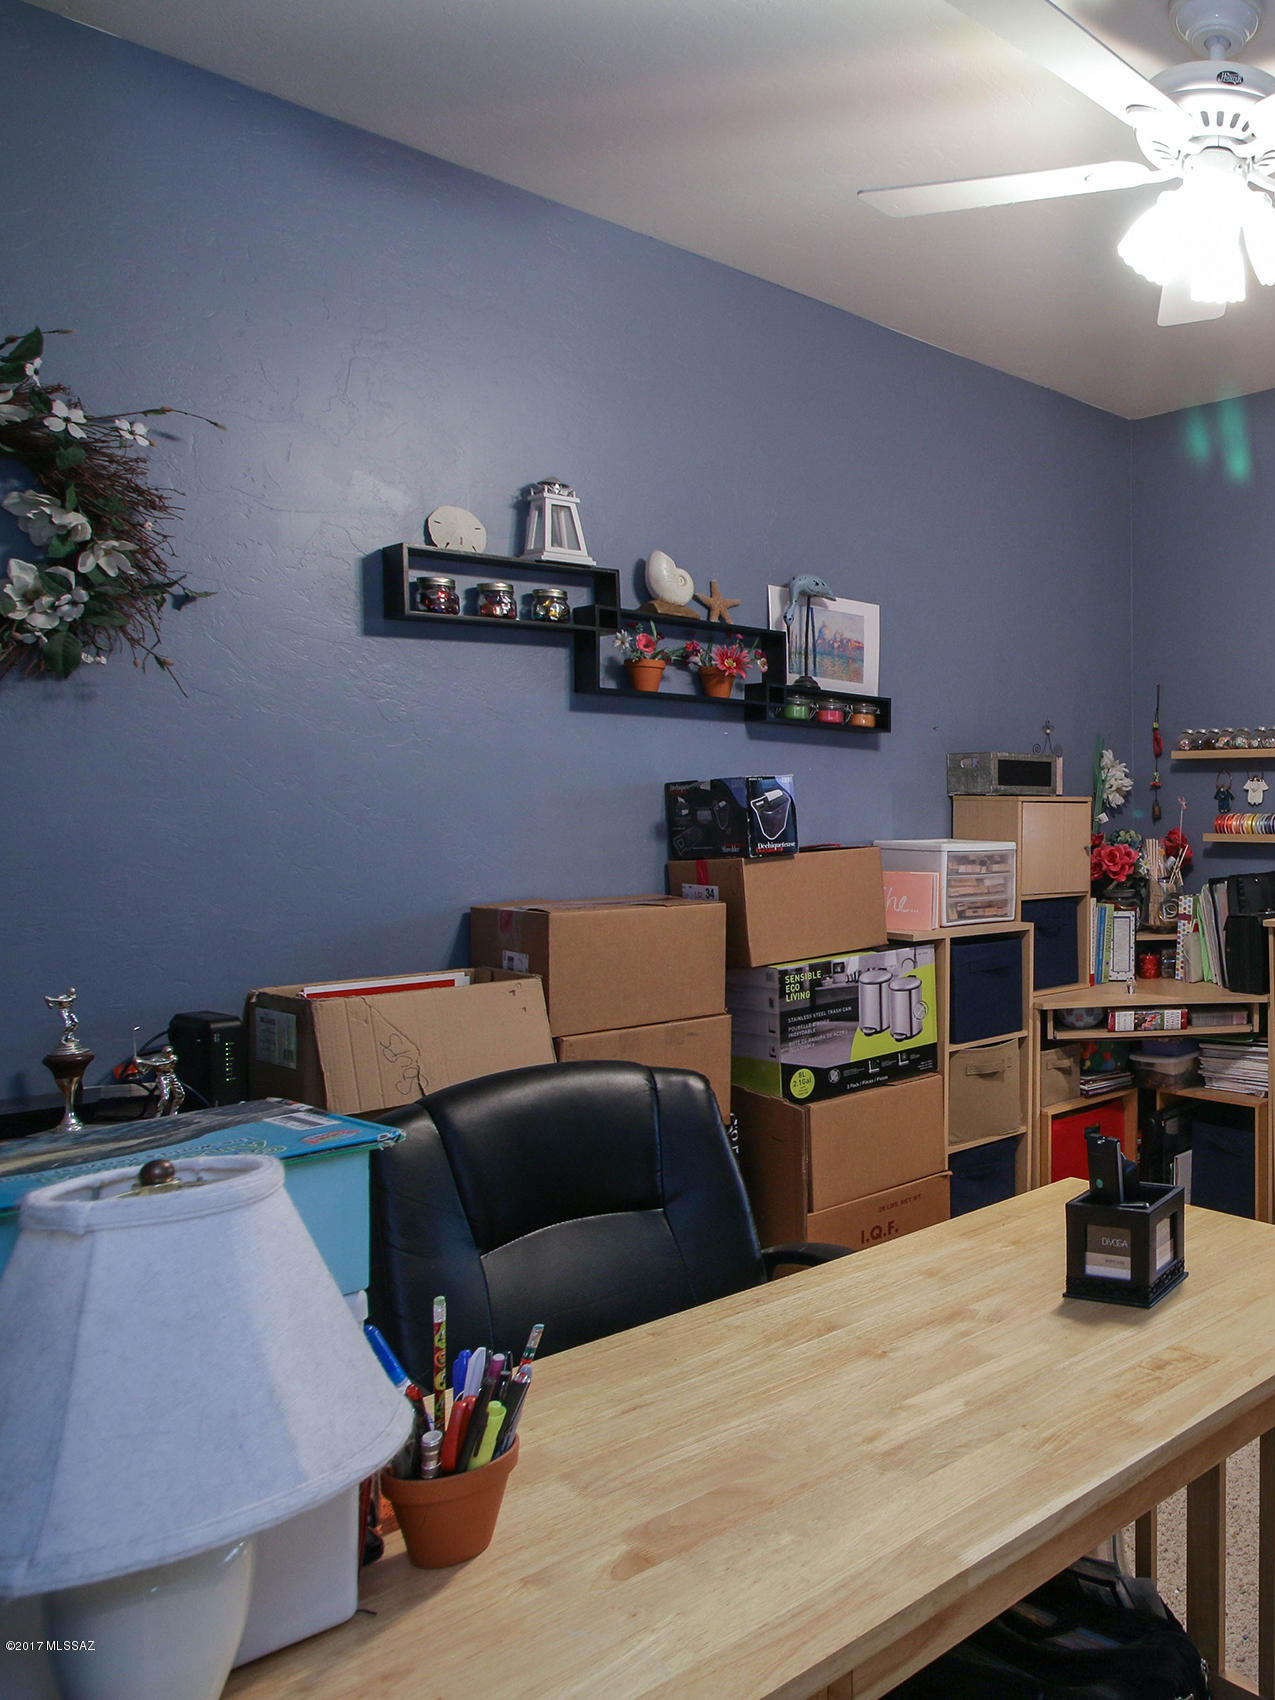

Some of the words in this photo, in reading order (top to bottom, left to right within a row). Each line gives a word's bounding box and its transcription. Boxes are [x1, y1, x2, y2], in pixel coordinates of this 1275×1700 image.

[785, 971, 822, 984] SENSIBLE
[785, 983, 801, 993] ECO
[786, 990, 811, 1003] LIVING
[861, 1220, 899, 1244] I.Q.F.
